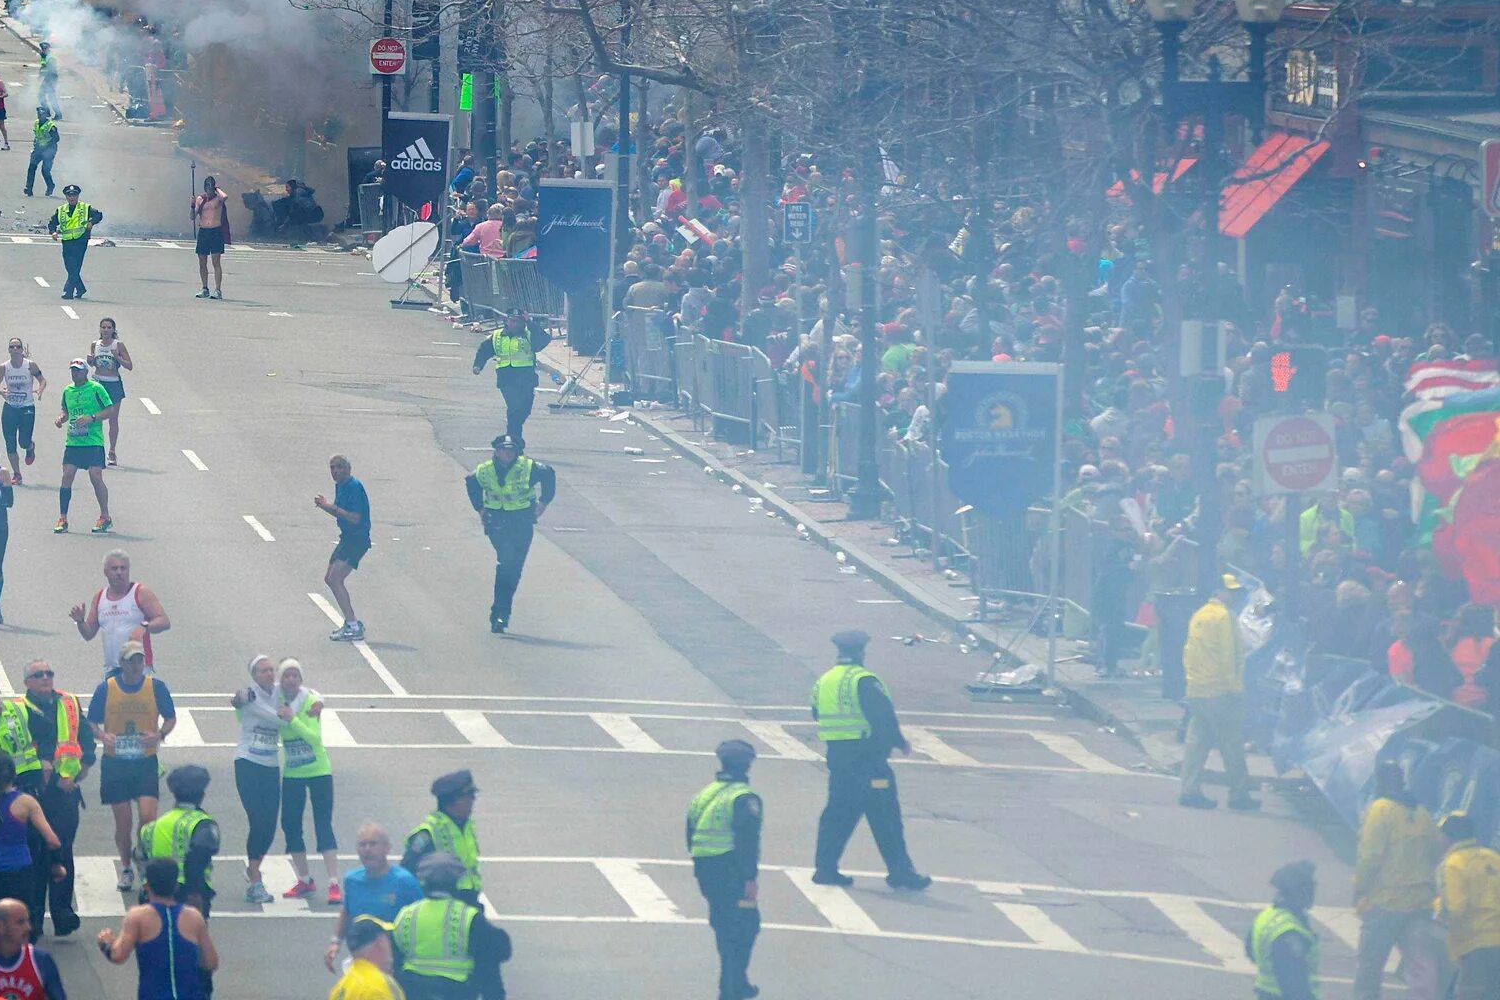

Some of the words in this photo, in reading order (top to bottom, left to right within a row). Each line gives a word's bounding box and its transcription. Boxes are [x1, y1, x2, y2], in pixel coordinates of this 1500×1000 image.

[390, 158, 442, 171] adidas
[541, 214, 568, 236] John
[568, 213, 607, 233] Hancock
[1276, 433, 1293, 446] DO
